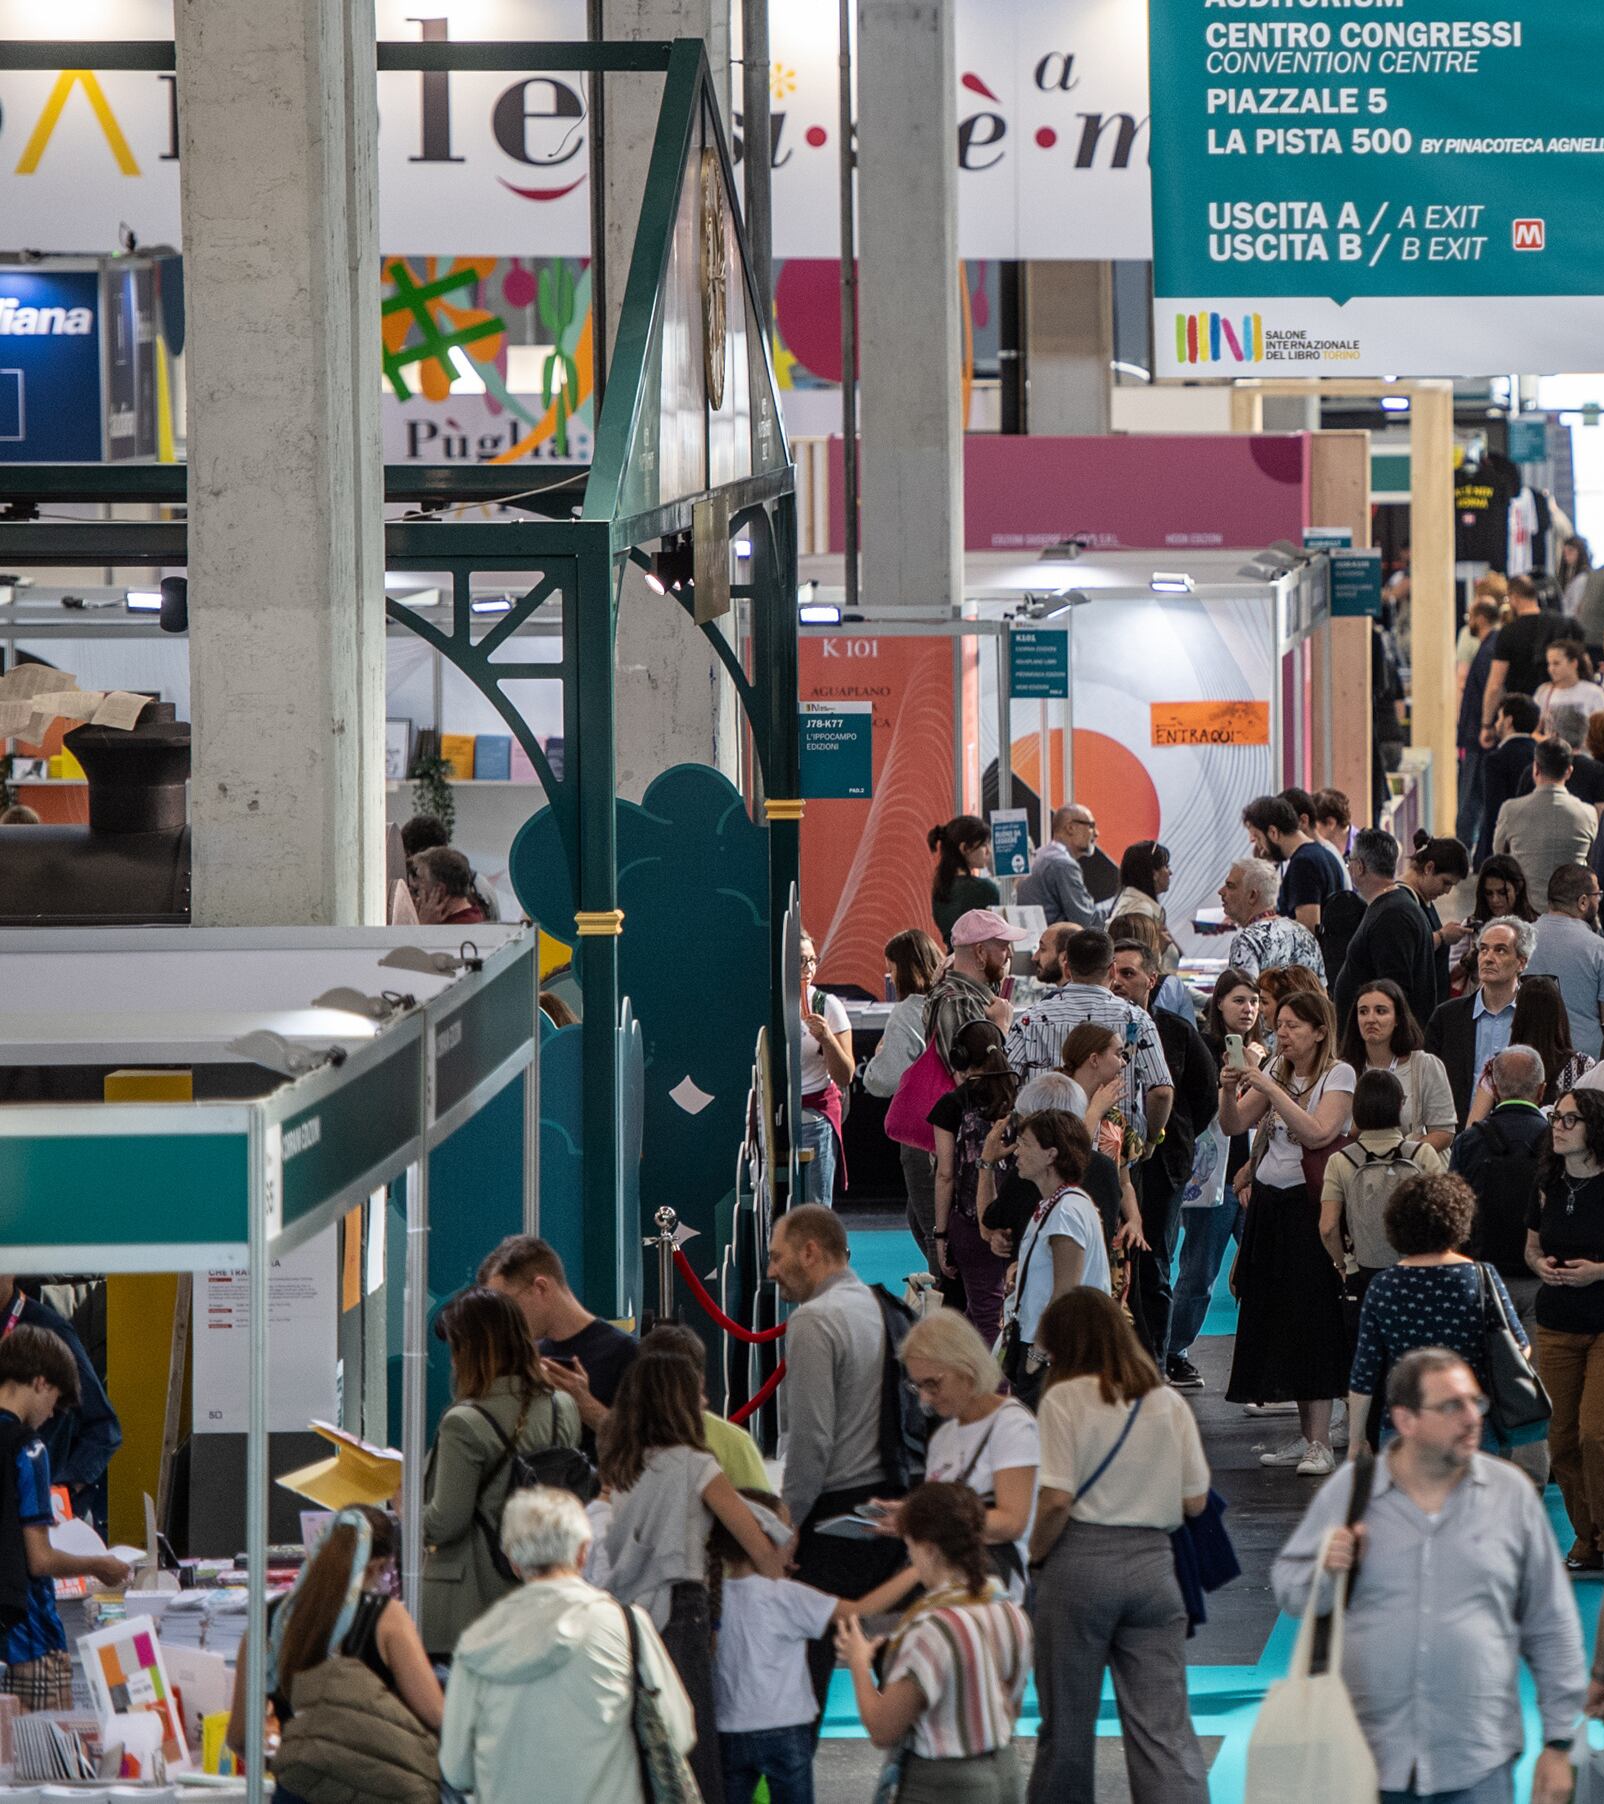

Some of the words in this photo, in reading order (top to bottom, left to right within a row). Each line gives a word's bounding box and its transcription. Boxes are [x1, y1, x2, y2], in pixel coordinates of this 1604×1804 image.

[1205, 22, 1331, 48] CENTRO
[1340, 21, 1522, 47] CONGRESSI
[1206, 51, 1371, 74] CONVENTION
[1378, 51, 1480, 73] CENTRE
[1207, 88, 1359, 114] PIAZZALE
[1368, 88, 1388, 113] 5
[1208, 129, 1247, 154] LA
[1256, 128, 1343, 154] PISTA
[1351, 128, 1413, 154] 500
[1420, 138, 1443, 154] BY
[1444, 137, 1544, 153] PINACOTECA
[1208, 202, 1329, 230] USCITA
[1336, 202, 1361, 229] A
[1398, 206, 1417, 229] A
[1425, 205, 1485, 229] EXIT
[1209, 234, 1330, 262] USCITA
[1339, 233, 1363, 261] B
[1402, 237, 1420, 261] B
[1428, 236, 1488, 260] EXIT
[0, 297, 93, 335] iana
[1265, 330, 1307, 340] SALONE
[1265, 340, 1360, 350] INTERNAZIONALE
[1265, 350, 1286, 361] DEL
[1288, 350, 1321, 361] LIBRO
[1322, 350, 1360, 360] TORINO
[822, 638, 840, 657] K
[847, 639, 879, 657] 101
[806, 719, 843, 728] J78-K77
[806, 732, 857, 741] L'IPPOCAMPO
[806, 743, 839, 751] EDIZIONI
